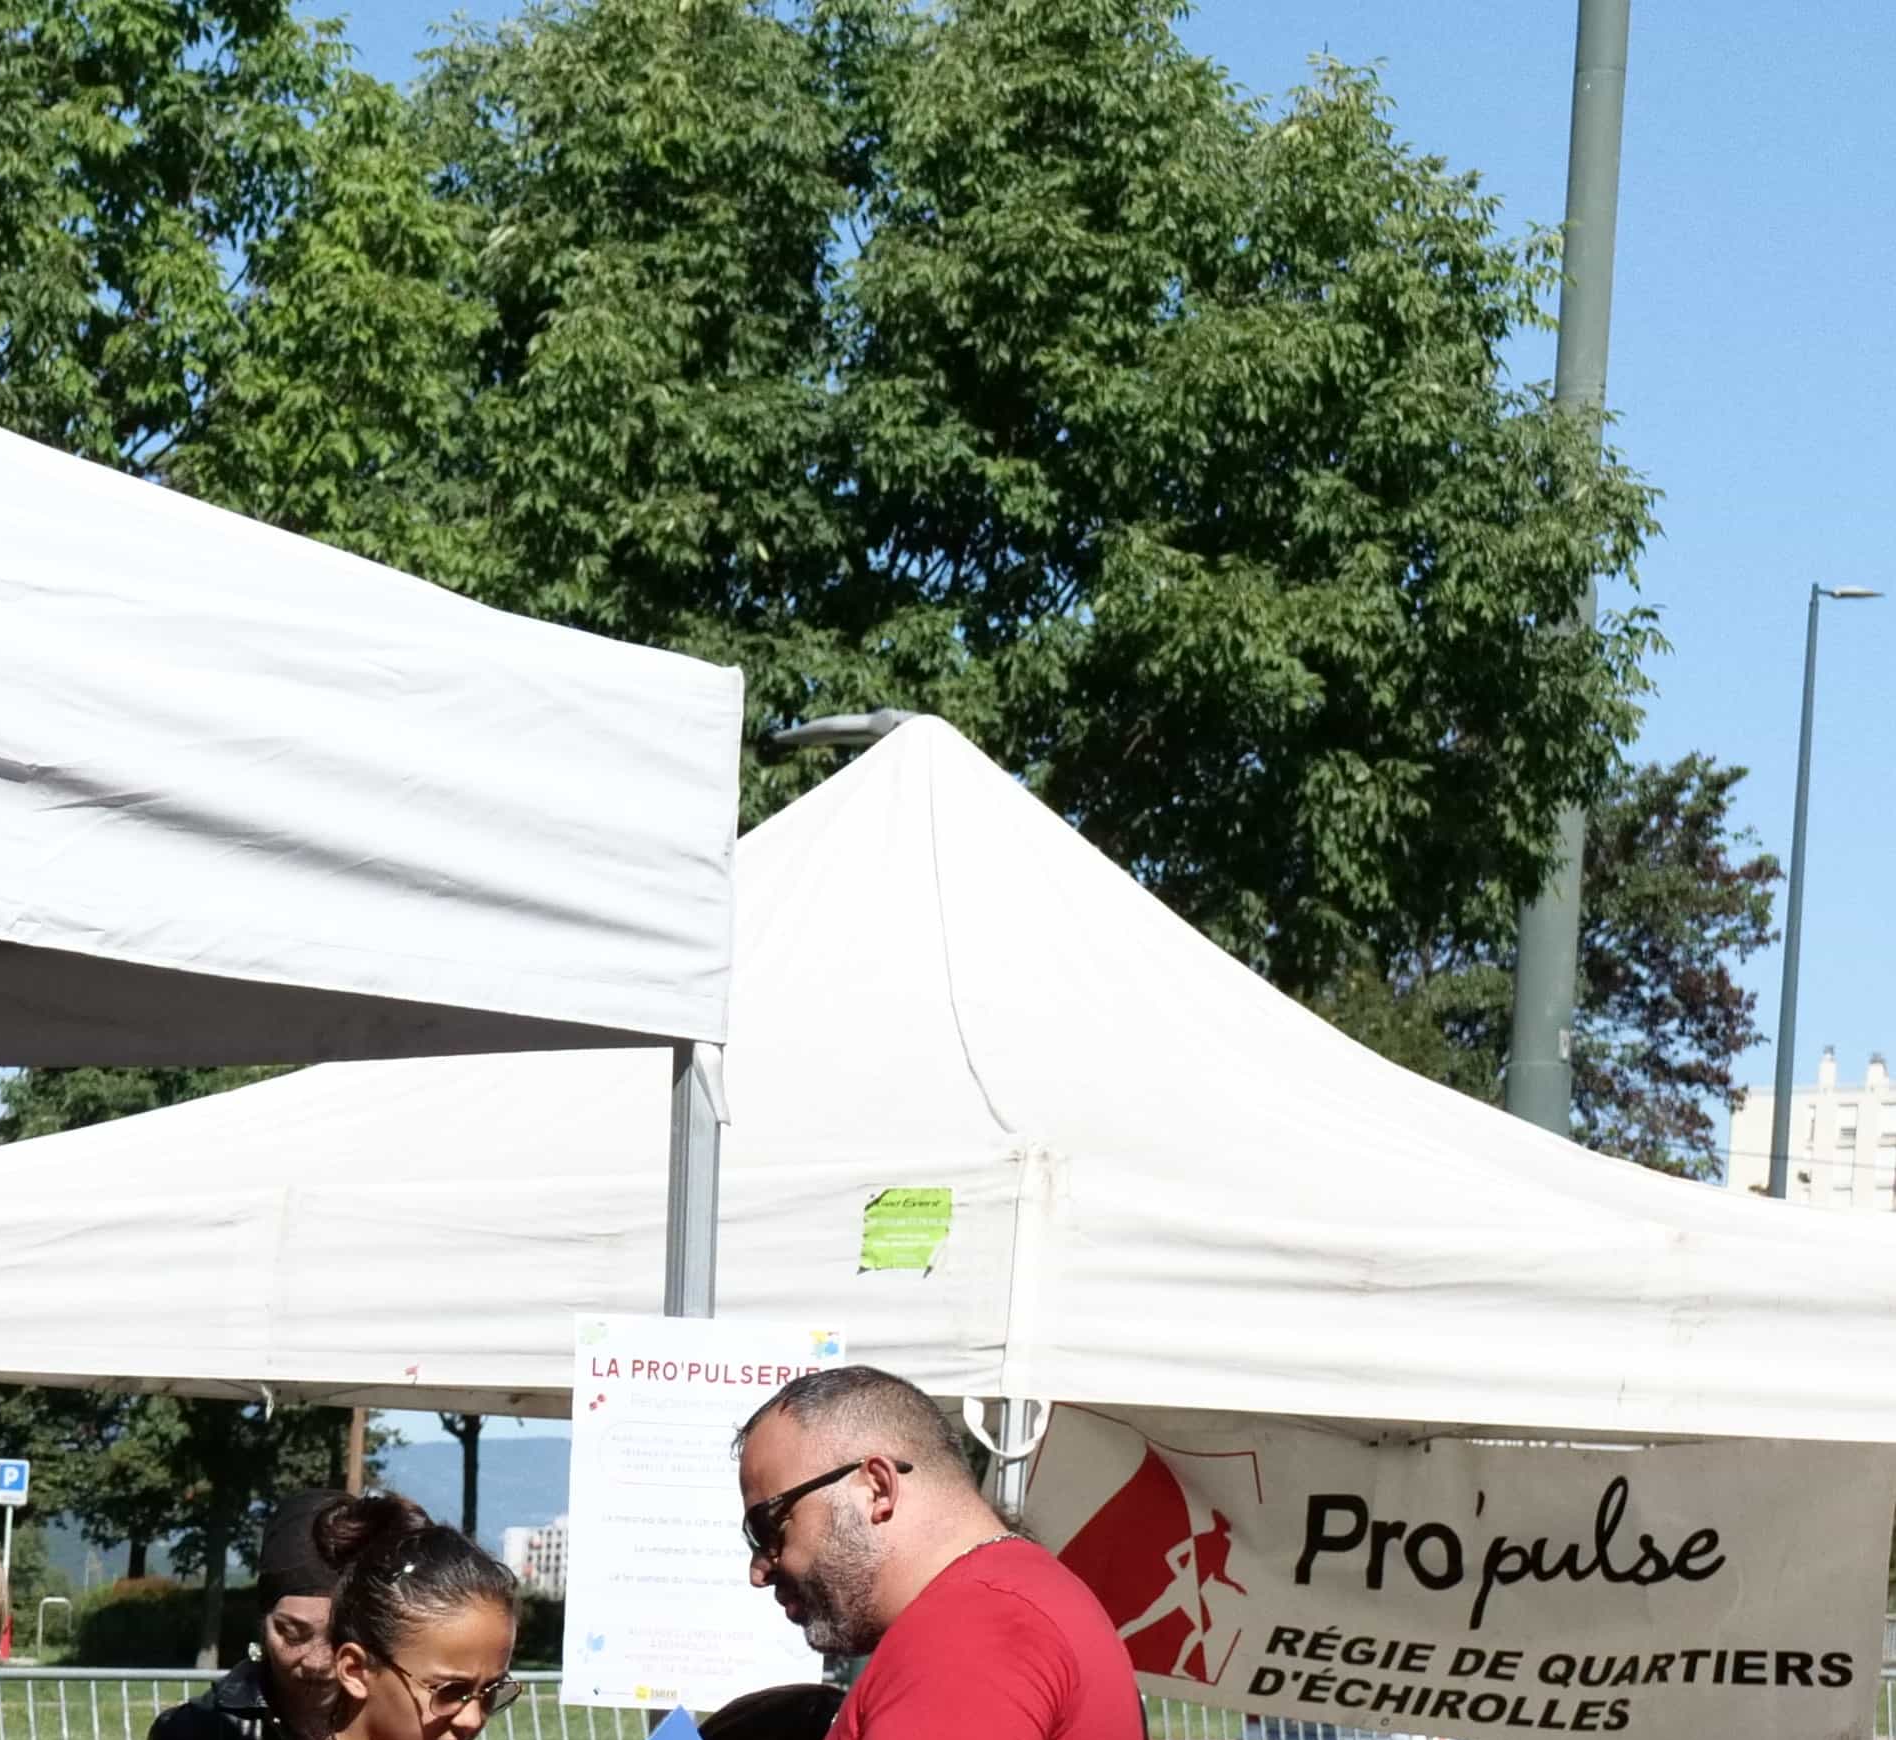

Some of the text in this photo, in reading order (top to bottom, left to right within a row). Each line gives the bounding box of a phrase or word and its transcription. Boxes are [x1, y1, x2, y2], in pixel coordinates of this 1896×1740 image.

[592, 1357, 820, 1386] LA PRO'PULSERI
[4, 1466, 20, 1488] P
[1294, 1474, 1726, 1630] Pro'pulse
[1265, 1625, 1855, 1689] RÉGIE DE QUARTIERS
[1247, 1665, 1632, 1733] D'ÉCHIROLLES
